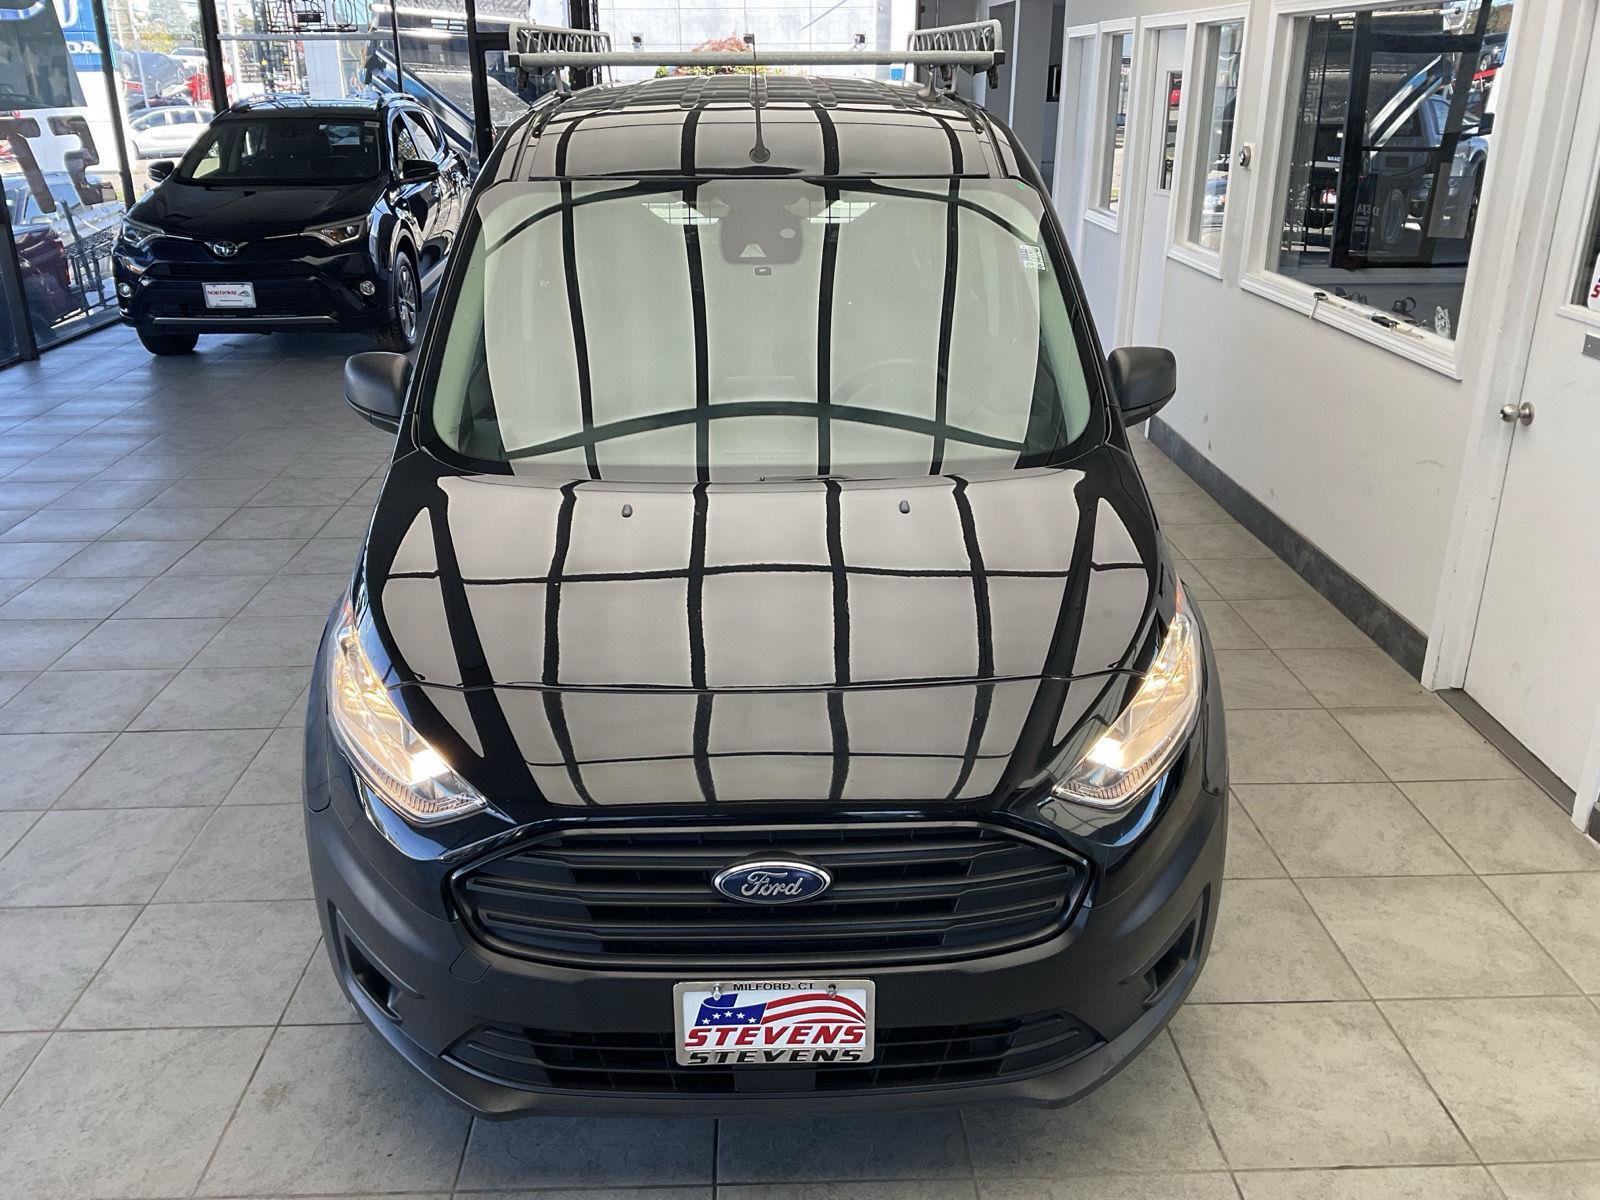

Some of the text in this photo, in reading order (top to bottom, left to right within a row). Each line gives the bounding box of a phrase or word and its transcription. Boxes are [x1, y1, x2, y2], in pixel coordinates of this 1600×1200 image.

[740, 871, 804, 896] Ford
[798, 982, 815, 991] CT
[685, 1026, 866, 1047] STEVENS
[687, 1050, 864, 1065] STEVENS
